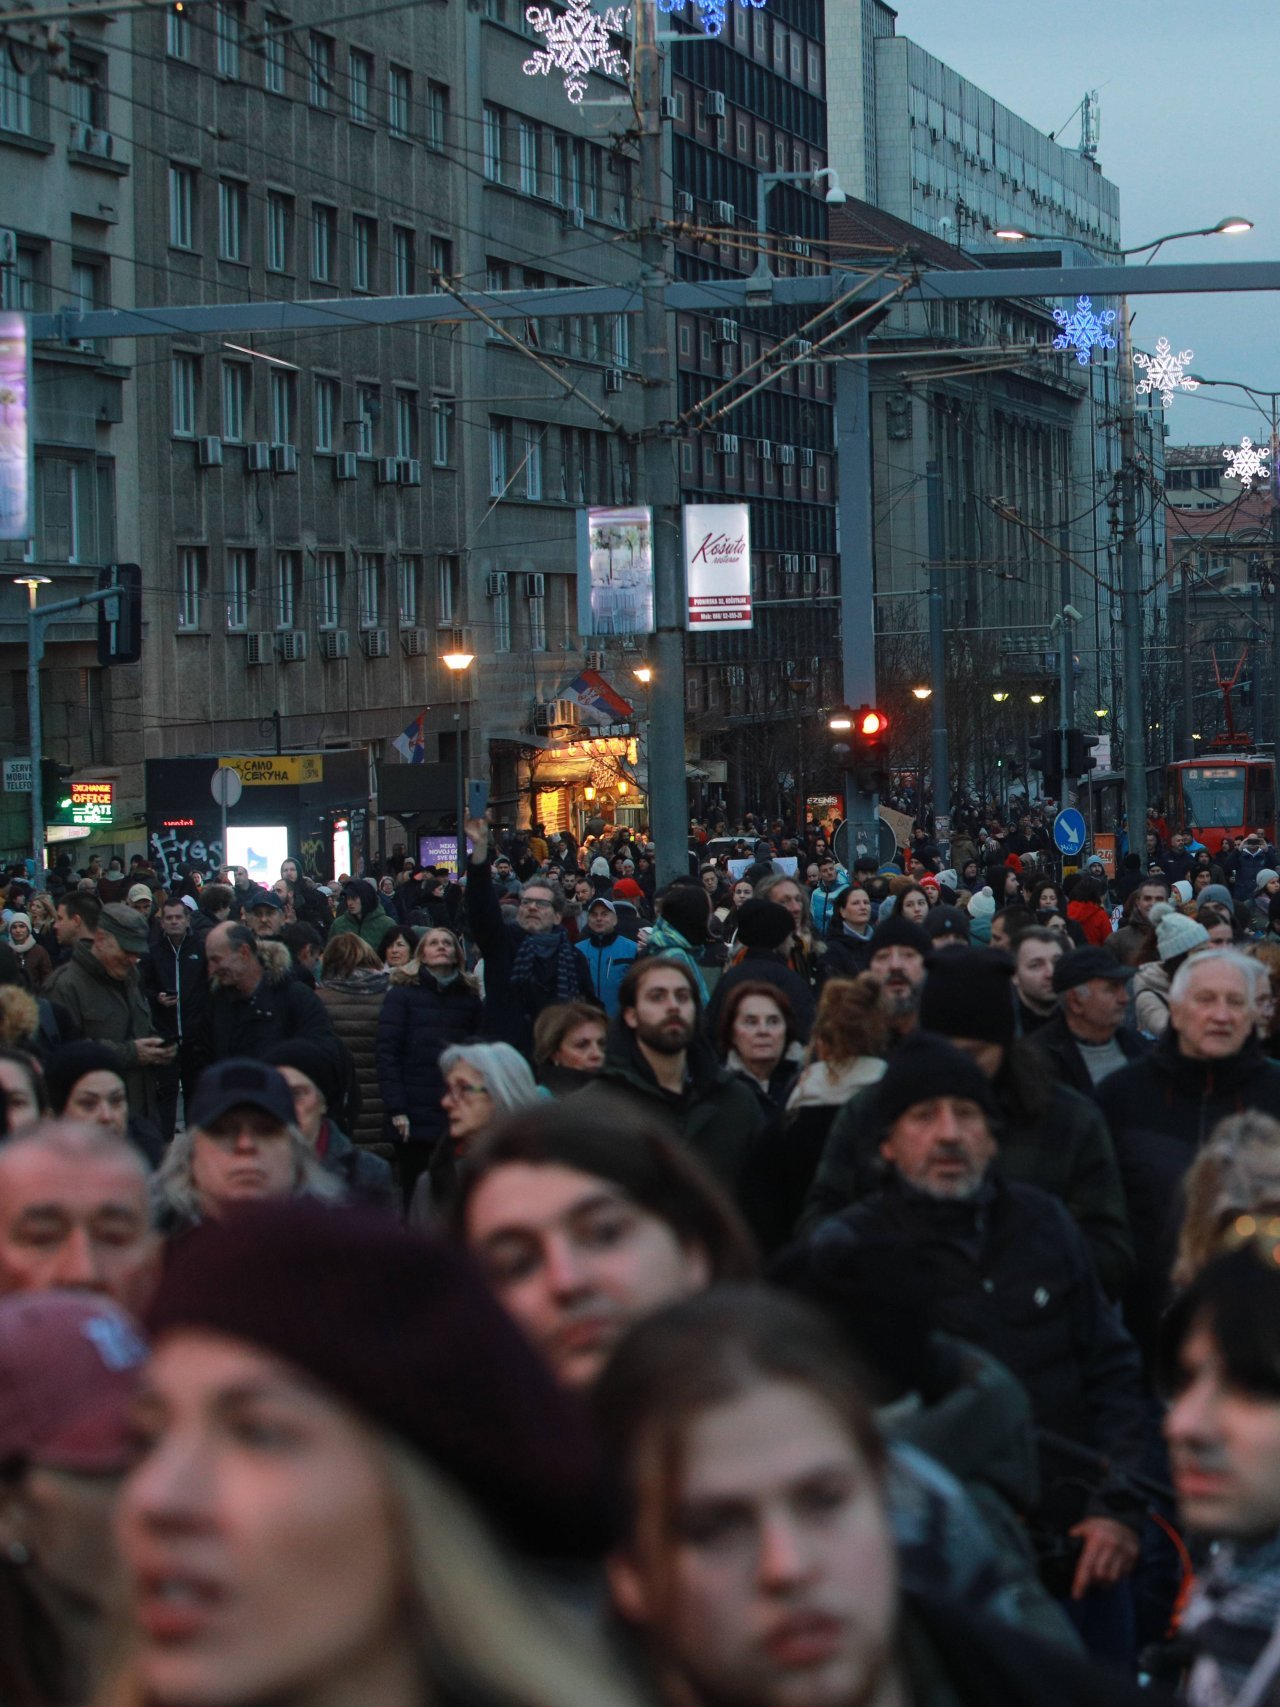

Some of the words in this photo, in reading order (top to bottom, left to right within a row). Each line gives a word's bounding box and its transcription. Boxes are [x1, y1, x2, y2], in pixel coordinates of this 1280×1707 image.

[692, 533, 746, 563] Košuta
[6, 773, 32, 781] MOBILN
[7, 781, 32, 790] TELEFO
[72, 784, 111, 792] EXCHANGE
[72, 793, 111, 804] OFFICE
